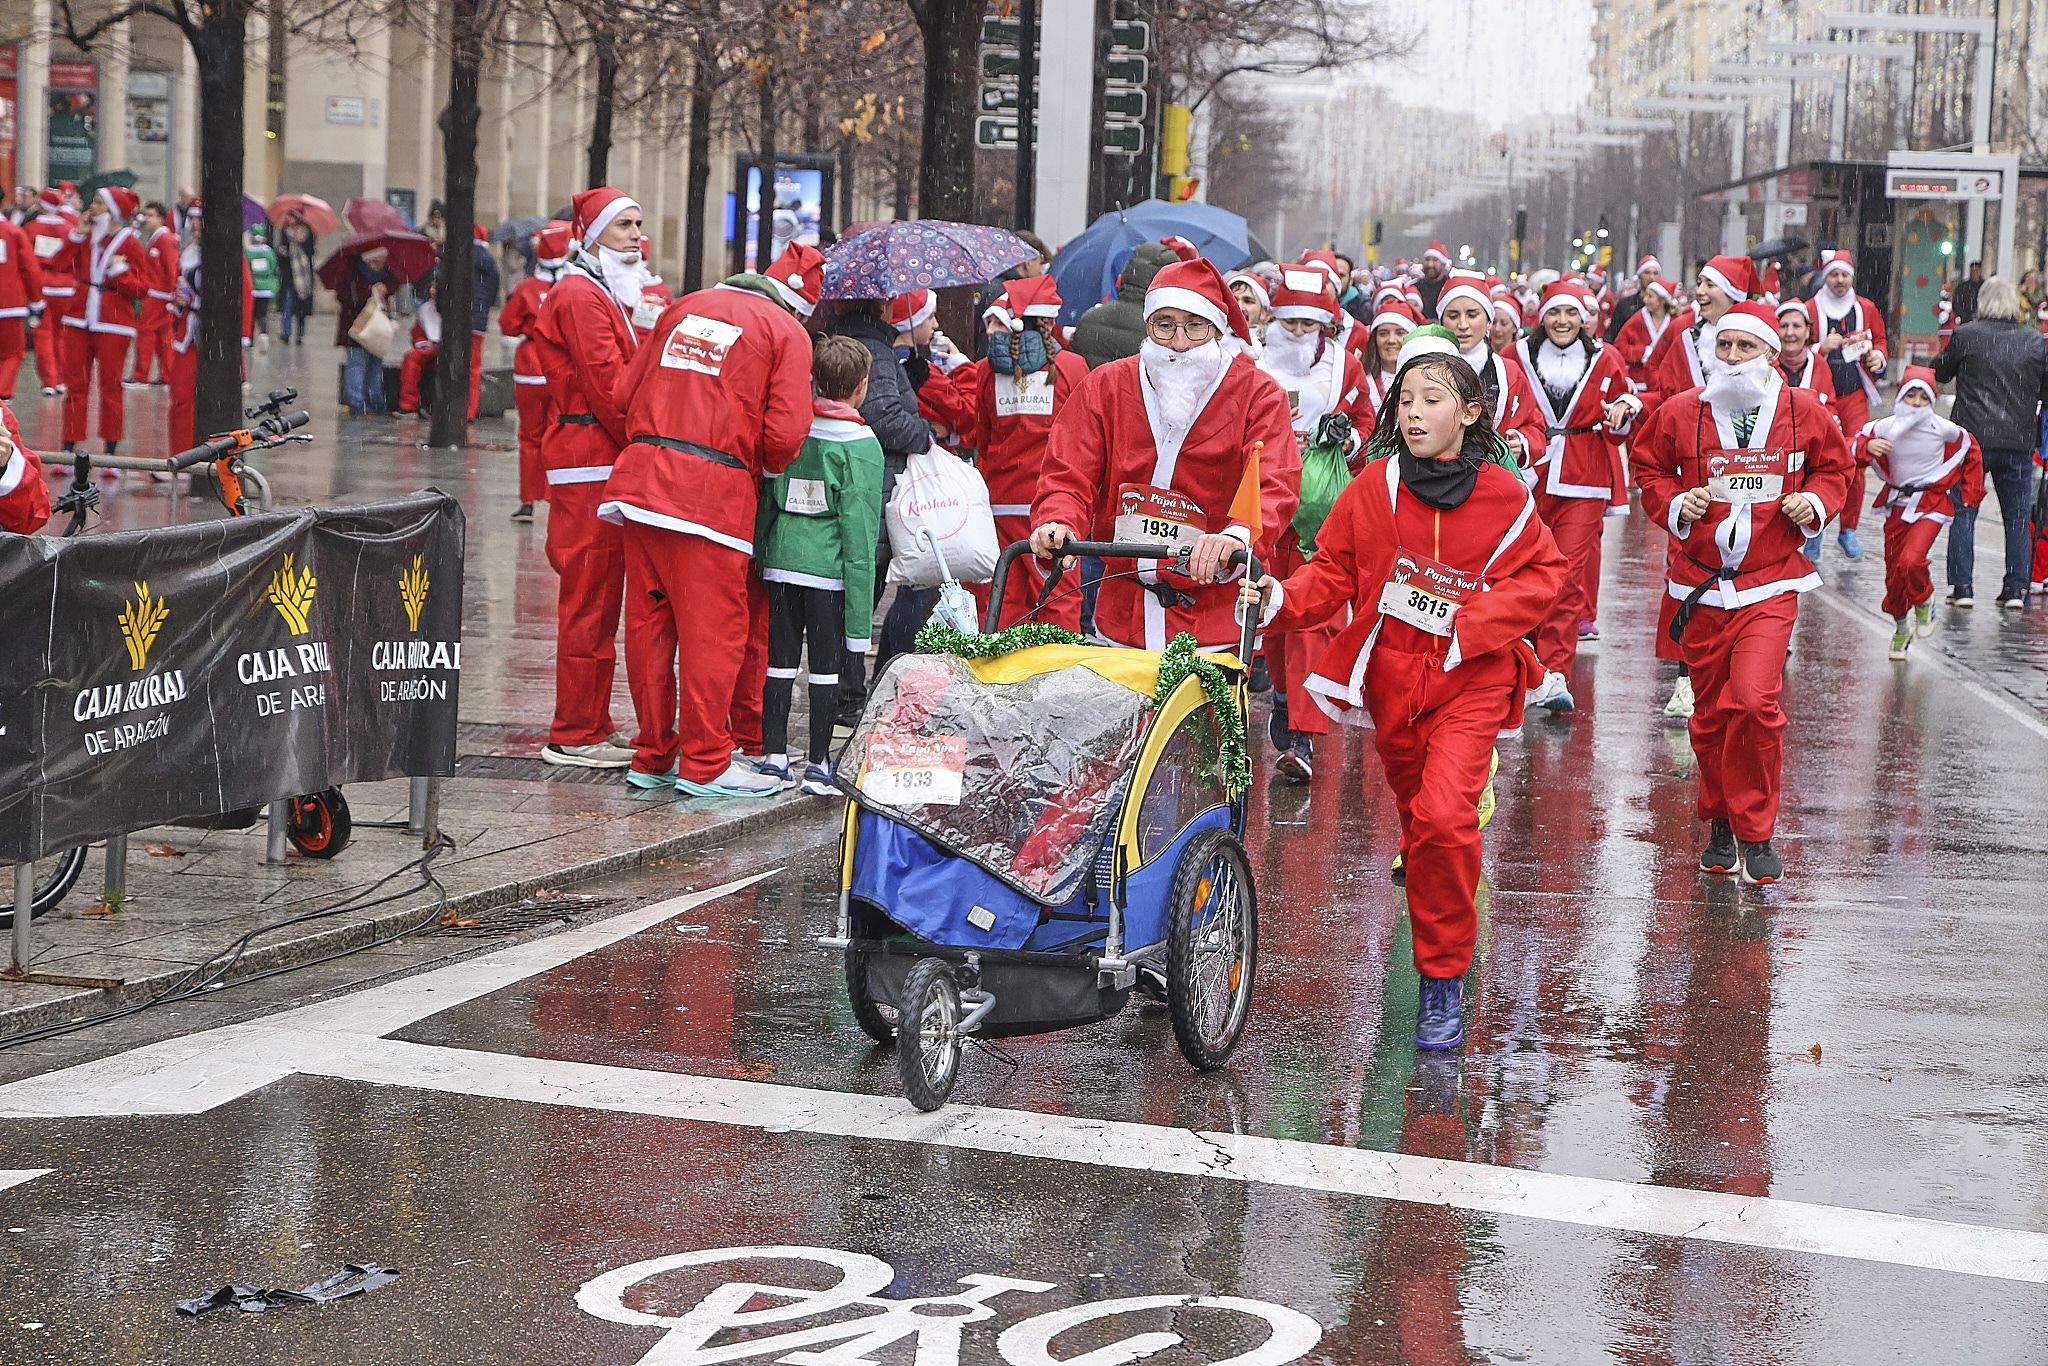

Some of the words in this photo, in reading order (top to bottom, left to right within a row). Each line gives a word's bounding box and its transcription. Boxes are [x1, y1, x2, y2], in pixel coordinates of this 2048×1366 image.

[998, 396, 1018, 406] CAJA
[1020, 396, 1050, 404] RURAL
[1734, 453, 1758, 464] Papá
[1760, 452, 1780, 462] Noel
[1730, 476, 1763, 490] 2709
[908, 497, 959, 517] Kinshasa
[1150, 493, 1176, 508] Papá
[1160, 508, 1172, 516] CAJA
[1172, 510, 1188, 518] RURAL
[1142, 518, 1178, 540] 1934
[1424, 566, 1454, 585] Papá
[1454, 577, 1478, 591] Noel
[1434, 584, 1446, 592] CAJA
[1408, 590, 1450, 618] 3615
[372, 641, 406, 670] CAJA
[237, 648, 298, 685] CAJA
[73, 683, 123, 722] CAJA
[122, 669, 188, 712] RURAL
[380, 680, 396, 702] DE
[397, 674, 446, 700] ARAGÓN
[256, 691, 286, 717] DE
[84, 730, 112, 756] DE
[114, 712, 170, 751] ARAGÓN
[900, 743, 930, 756] Papá
[935, 742, 960, 754] Noel
[892, 770, 933, 789] 1933
